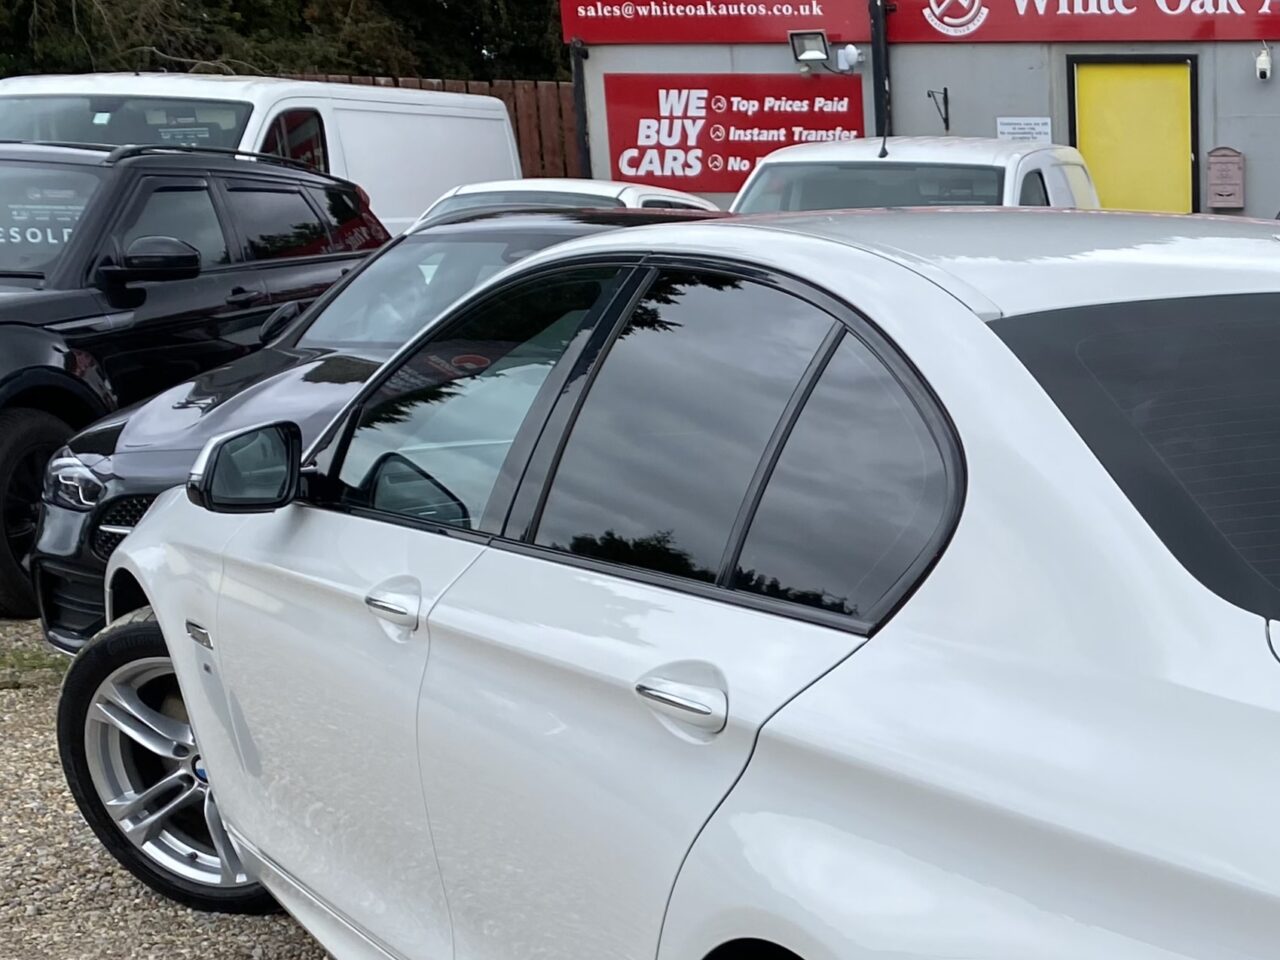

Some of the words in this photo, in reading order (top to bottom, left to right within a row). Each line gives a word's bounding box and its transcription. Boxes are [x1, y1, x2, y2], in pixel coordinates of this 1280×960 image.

[577, 0, 824, 17] sales@whiteoakautos.co.uk
[658, 89, 709, 117] WE
[730, 97, 759, 114] Top
[764, 96, 809, 112] Prices
[814, 96, 849, 112] Paid
[637, 118, 707, 147] BUY
[729, 125, 787, 142] Instant
[791, 126, 858, 142] Transfer
[618, 148, 703, 176] CARS
[727, 156, 751, 172] No
